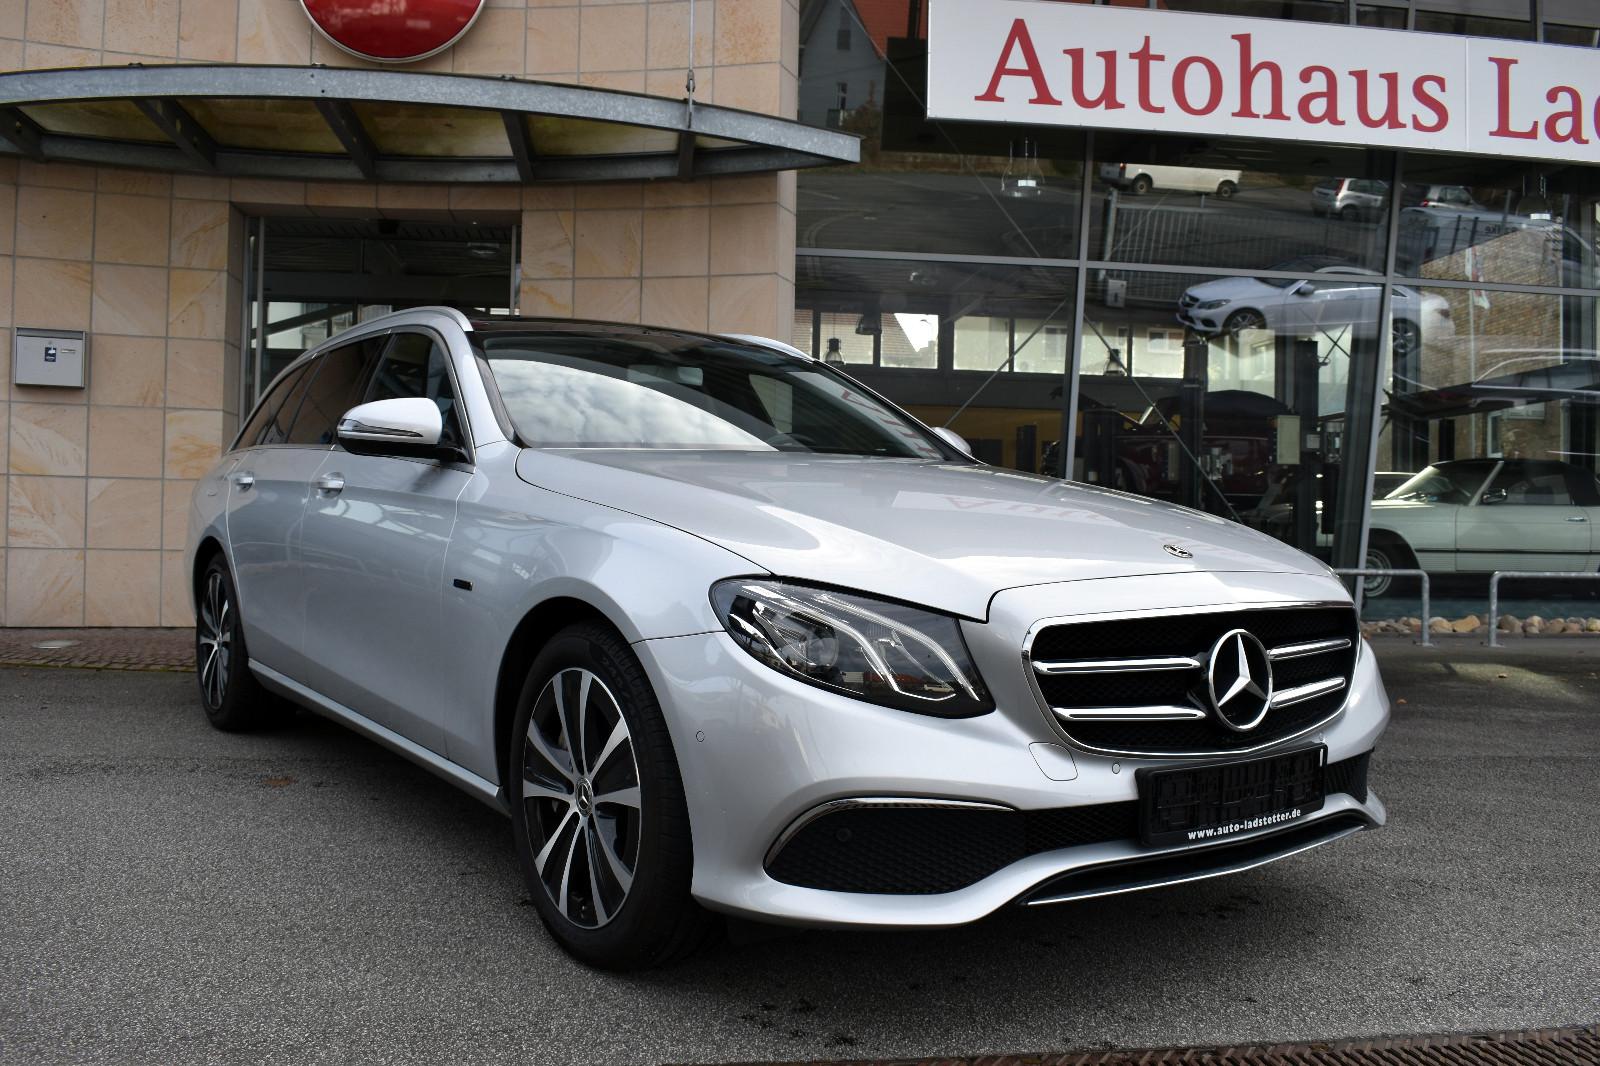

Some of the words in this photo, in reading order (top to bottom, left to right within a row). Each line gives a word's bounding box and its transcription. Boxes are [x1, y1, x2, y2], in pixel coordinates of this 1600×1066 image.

[975, 19, 1449, 132] Autohaus
[1488, 56, 1600, 145] La
[1187, 808, 1301, 839] www.auto-ladstetter.de
